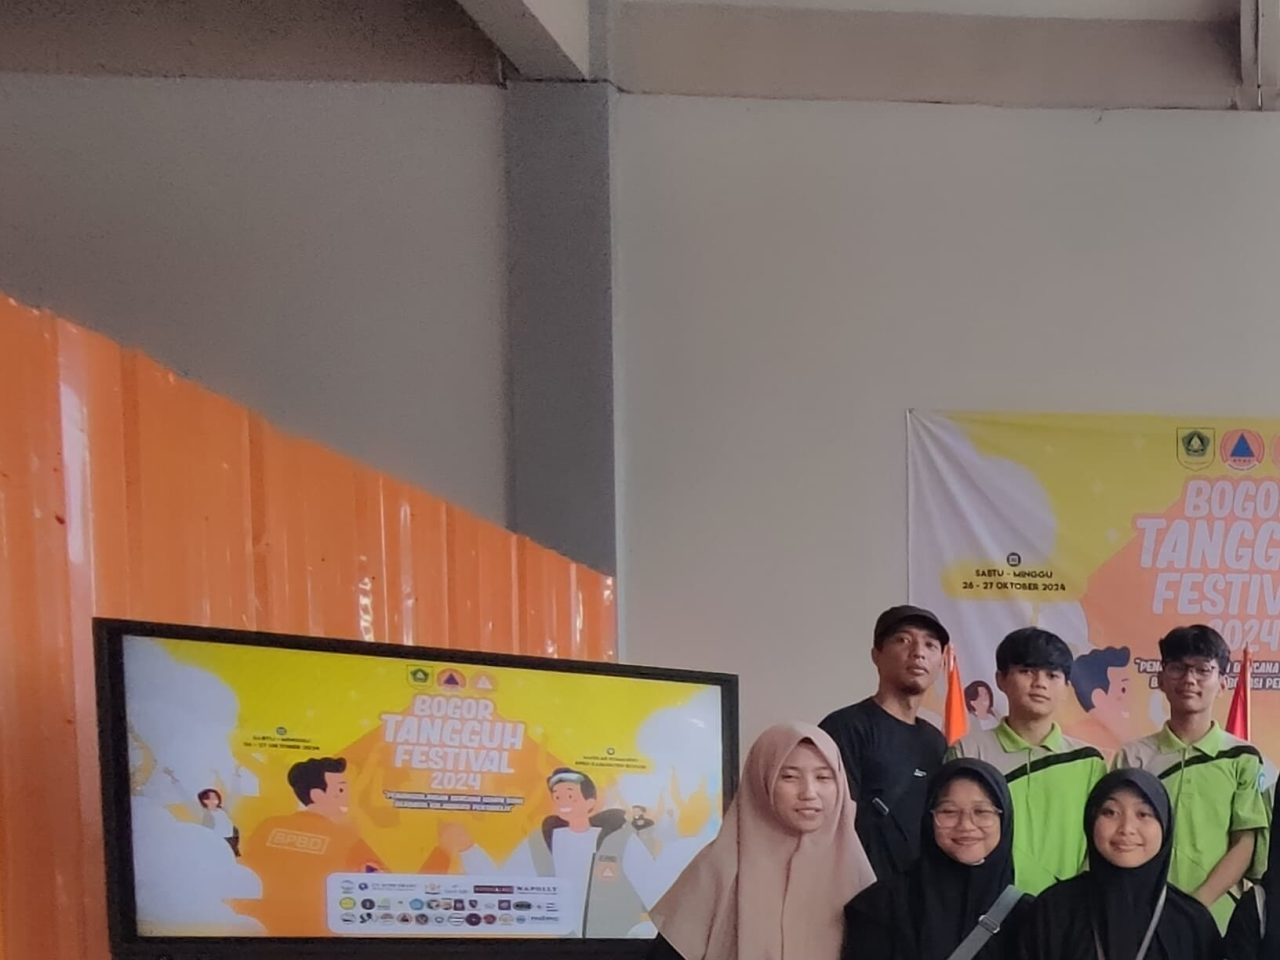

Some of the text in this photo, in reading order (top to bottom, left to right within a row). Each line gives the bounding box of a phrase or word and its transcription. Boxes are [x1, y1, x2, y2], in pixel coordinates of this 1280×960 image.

[975, 569, 1004, 578] SABTU
[1013, 571, 1053, 579] MINGGU
[962, 581, 974, 590] 26
[983, 581, 993, 590] 27
[996, 582, 1039, 591] OKTOBER
[1042, 583, 1066, 591] 2024
[414, 695, 494, 720] BOGOR
[381, 714, 525, 749] TANGGUH
[395, 745, 515, 773] FESTIVAL
[430, 772, 481, 790] 2024
